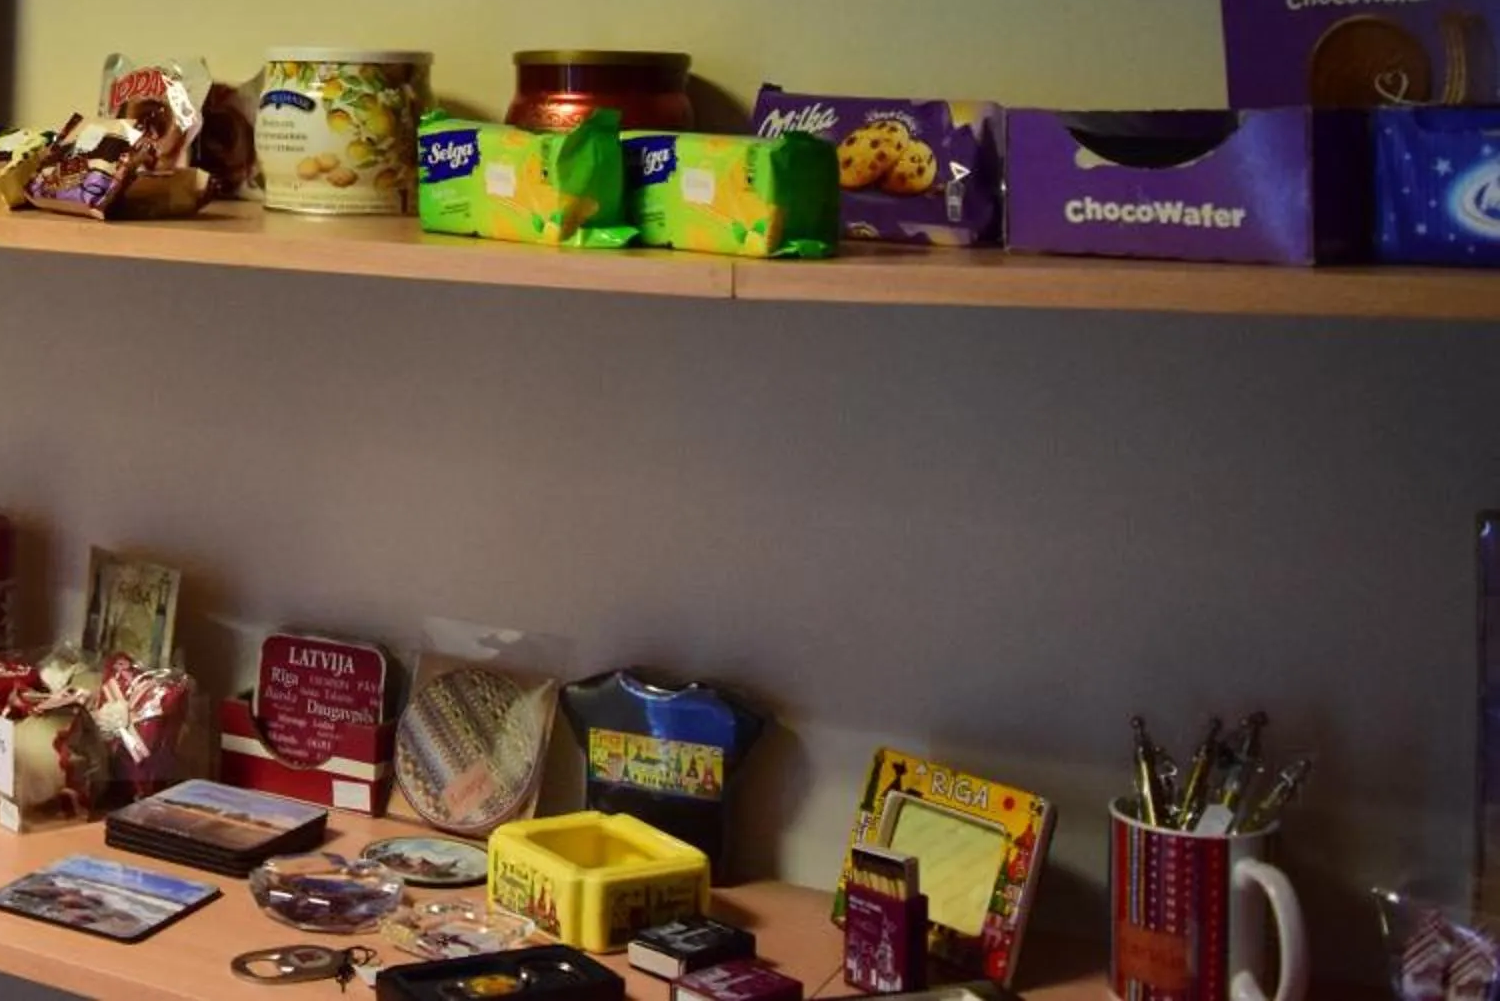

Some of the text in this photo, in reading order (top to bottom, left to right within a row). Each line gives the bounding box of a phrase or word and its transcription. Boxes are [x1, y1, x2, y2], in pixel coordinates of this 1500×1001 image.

[757, 102, 840, 139] Milka
[427, 141, 476, 169] Selga
[1064, 196, 1247, 230] ChocoWafer
[288, 646, 356, 678] LATVIJA
[930, 769, 990, 810] RIGA
